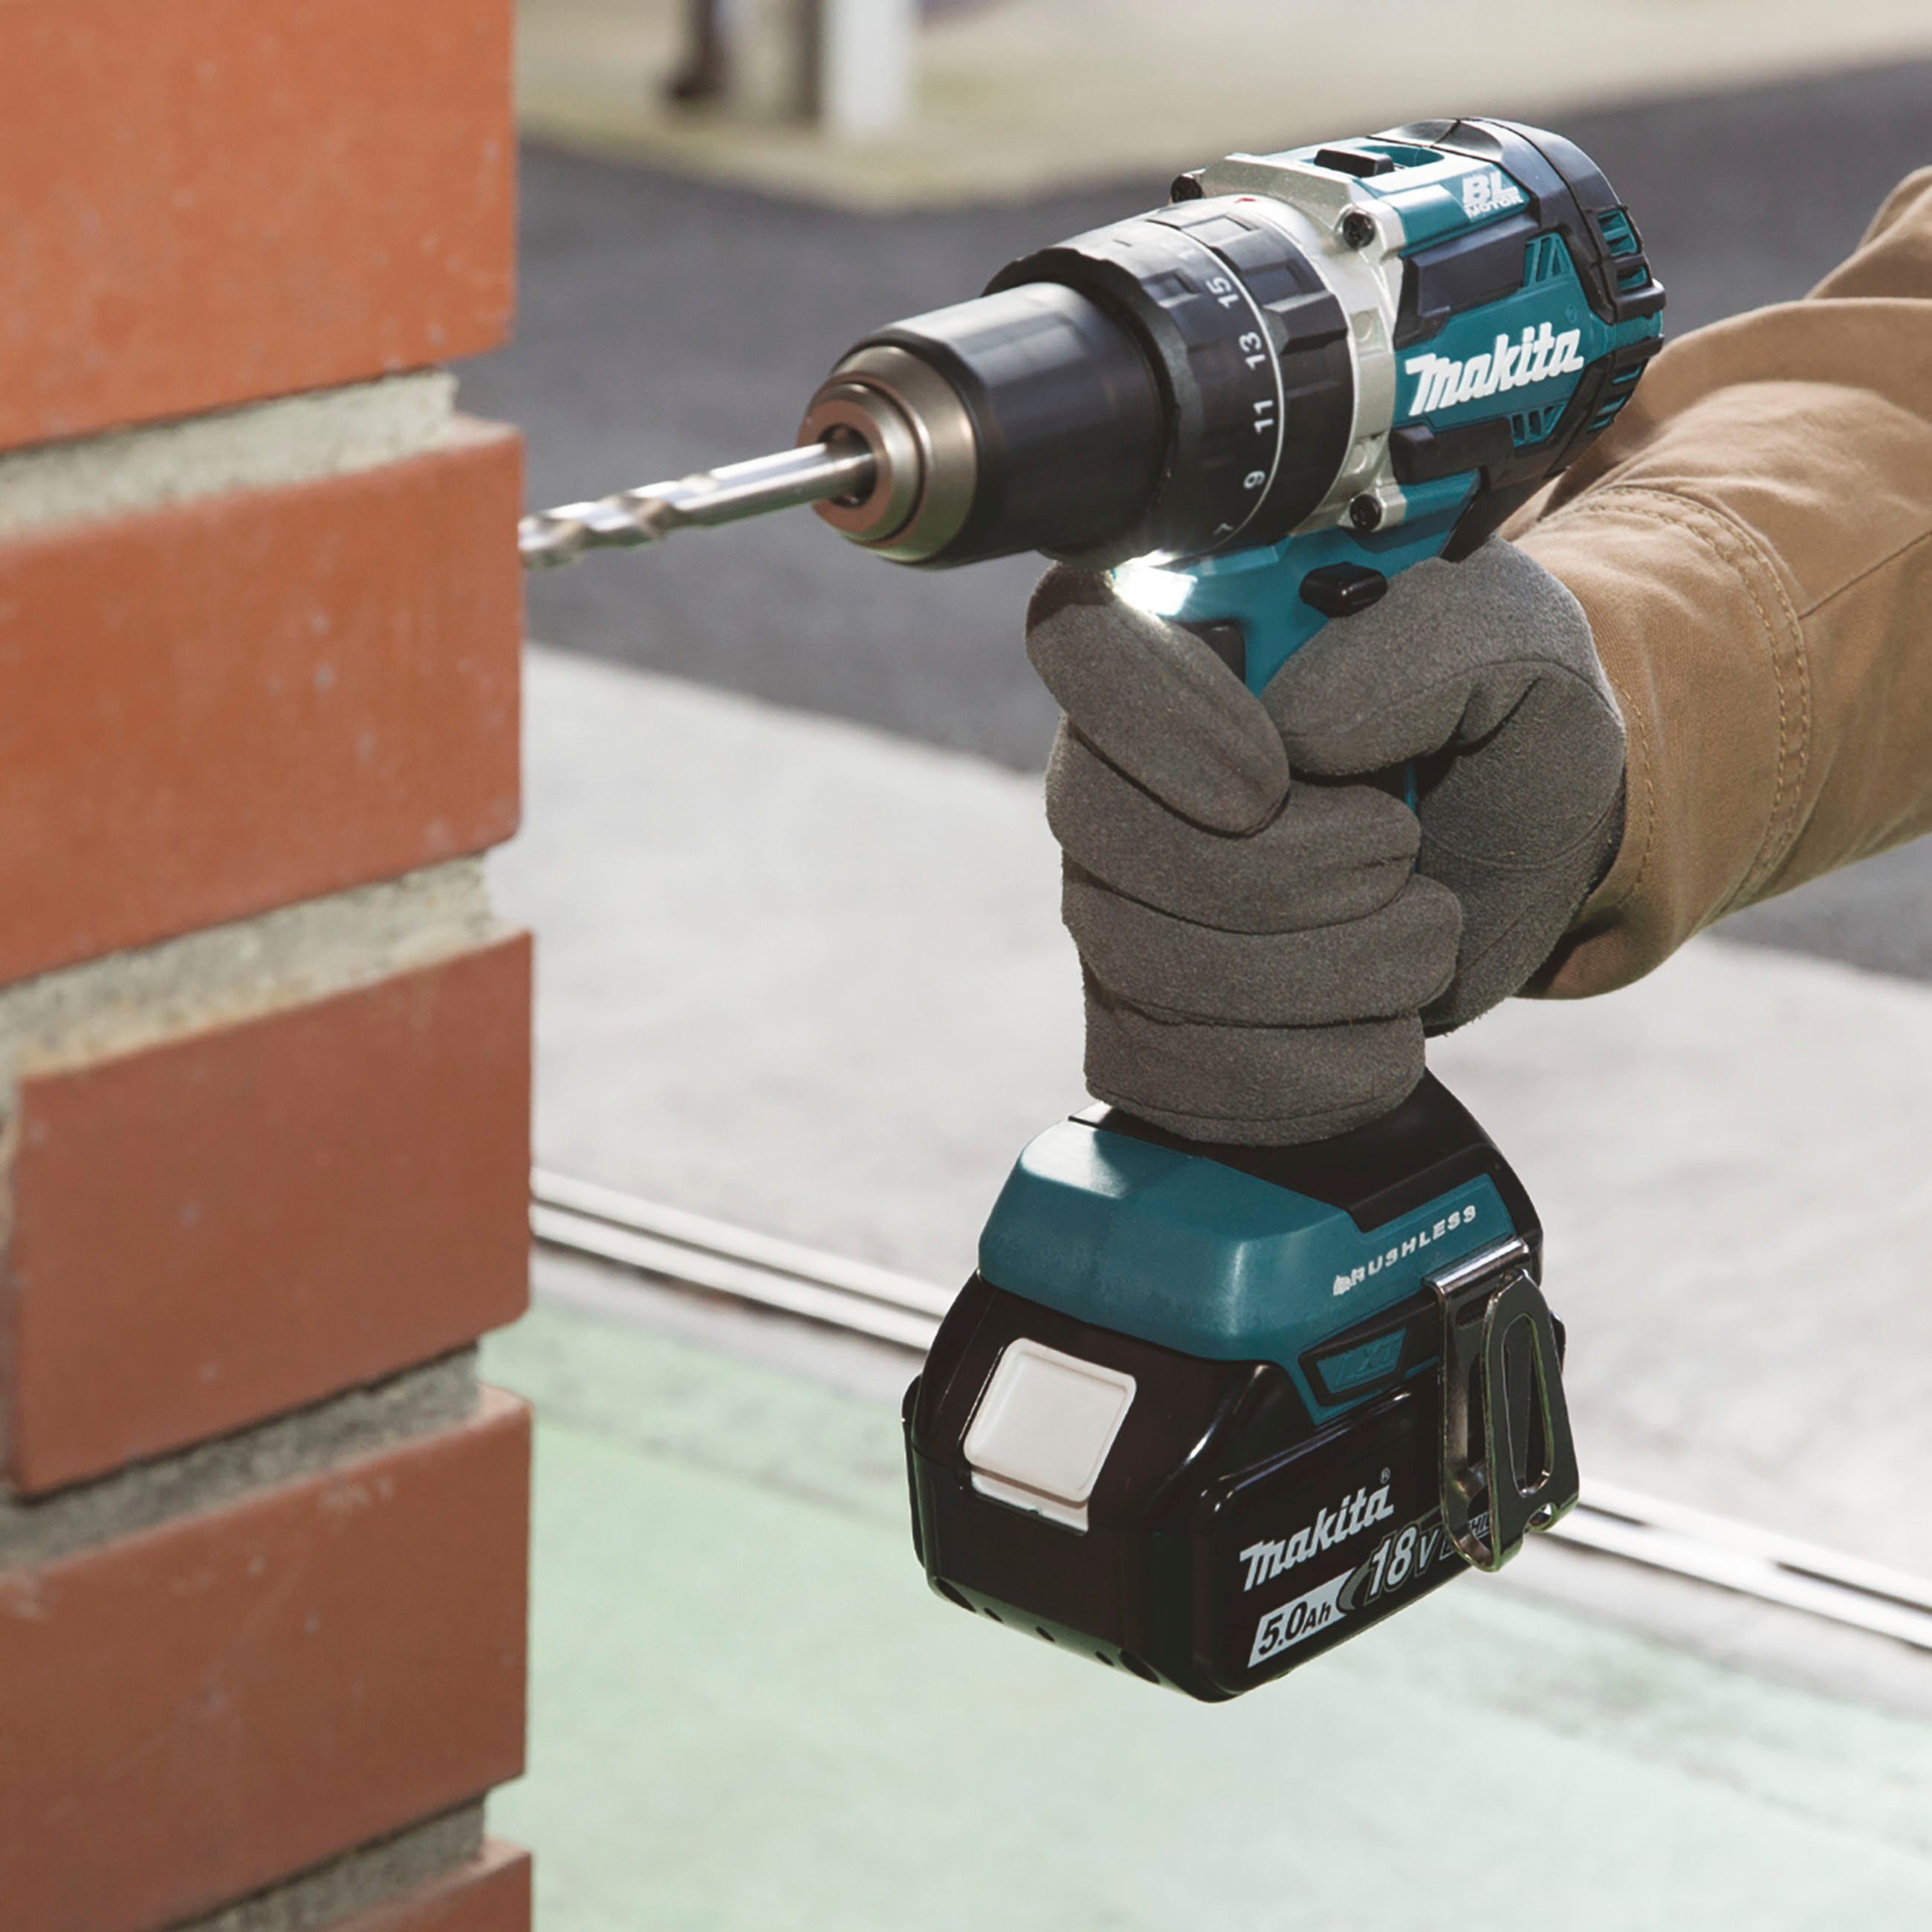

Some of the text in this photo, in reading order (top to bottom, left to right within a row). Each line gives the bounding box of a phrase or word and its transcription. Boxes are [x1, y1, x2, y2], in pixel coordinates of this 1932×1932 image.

[1462, 169, 1519, 205] BL
[1463, 194, 1524, 218] MOTOR
[1206, 276, 1239, 309] 15
[1239, 331, 1266, 370] 13
[1253, 399, 1274, 434] 11
[1243, 470, 1265, 489] 9
[1258, 1526, 1440, 1656] 5.0Ah 18V
